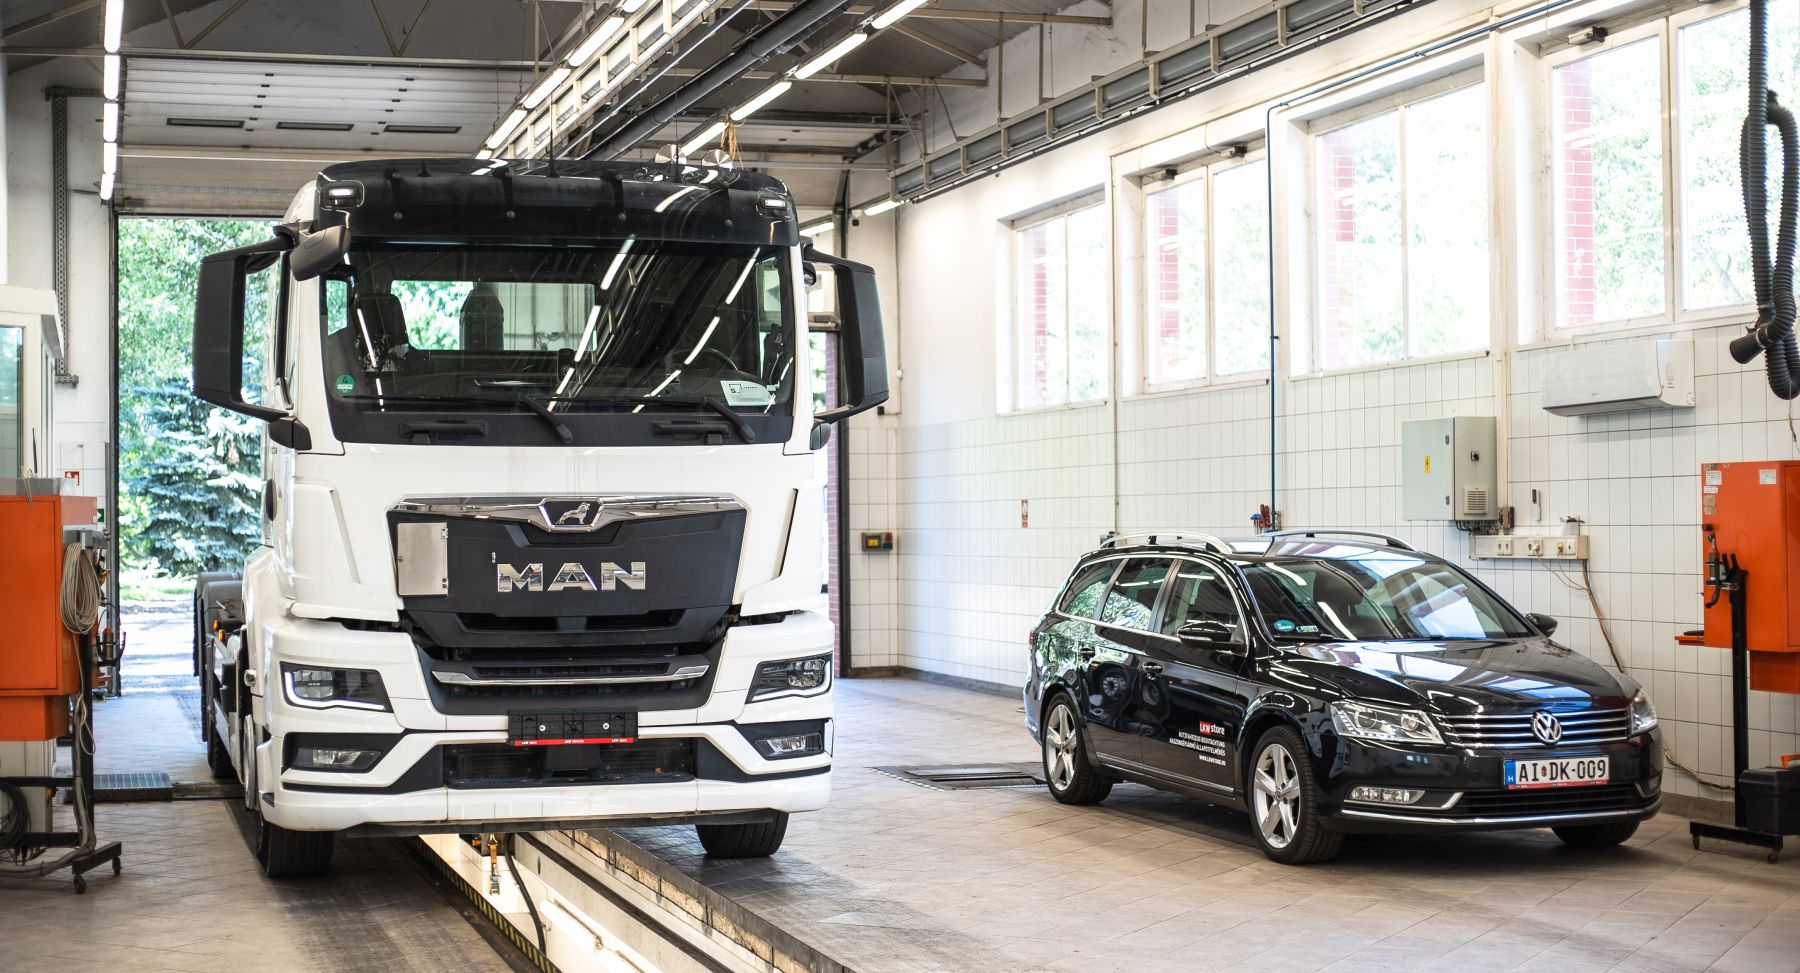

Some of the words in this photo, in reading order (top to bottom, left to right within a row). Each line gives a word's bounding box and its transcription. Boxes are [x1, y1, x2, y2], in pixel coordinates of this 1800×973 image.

[497, 561, 646, 593] MAN
[1200, 723, 1211, 733] LKW
[1211, 724, 1225, 735] store
[1519, 763, 1539, 782] AI
[1549, 759, 1606, 781] DK-009
